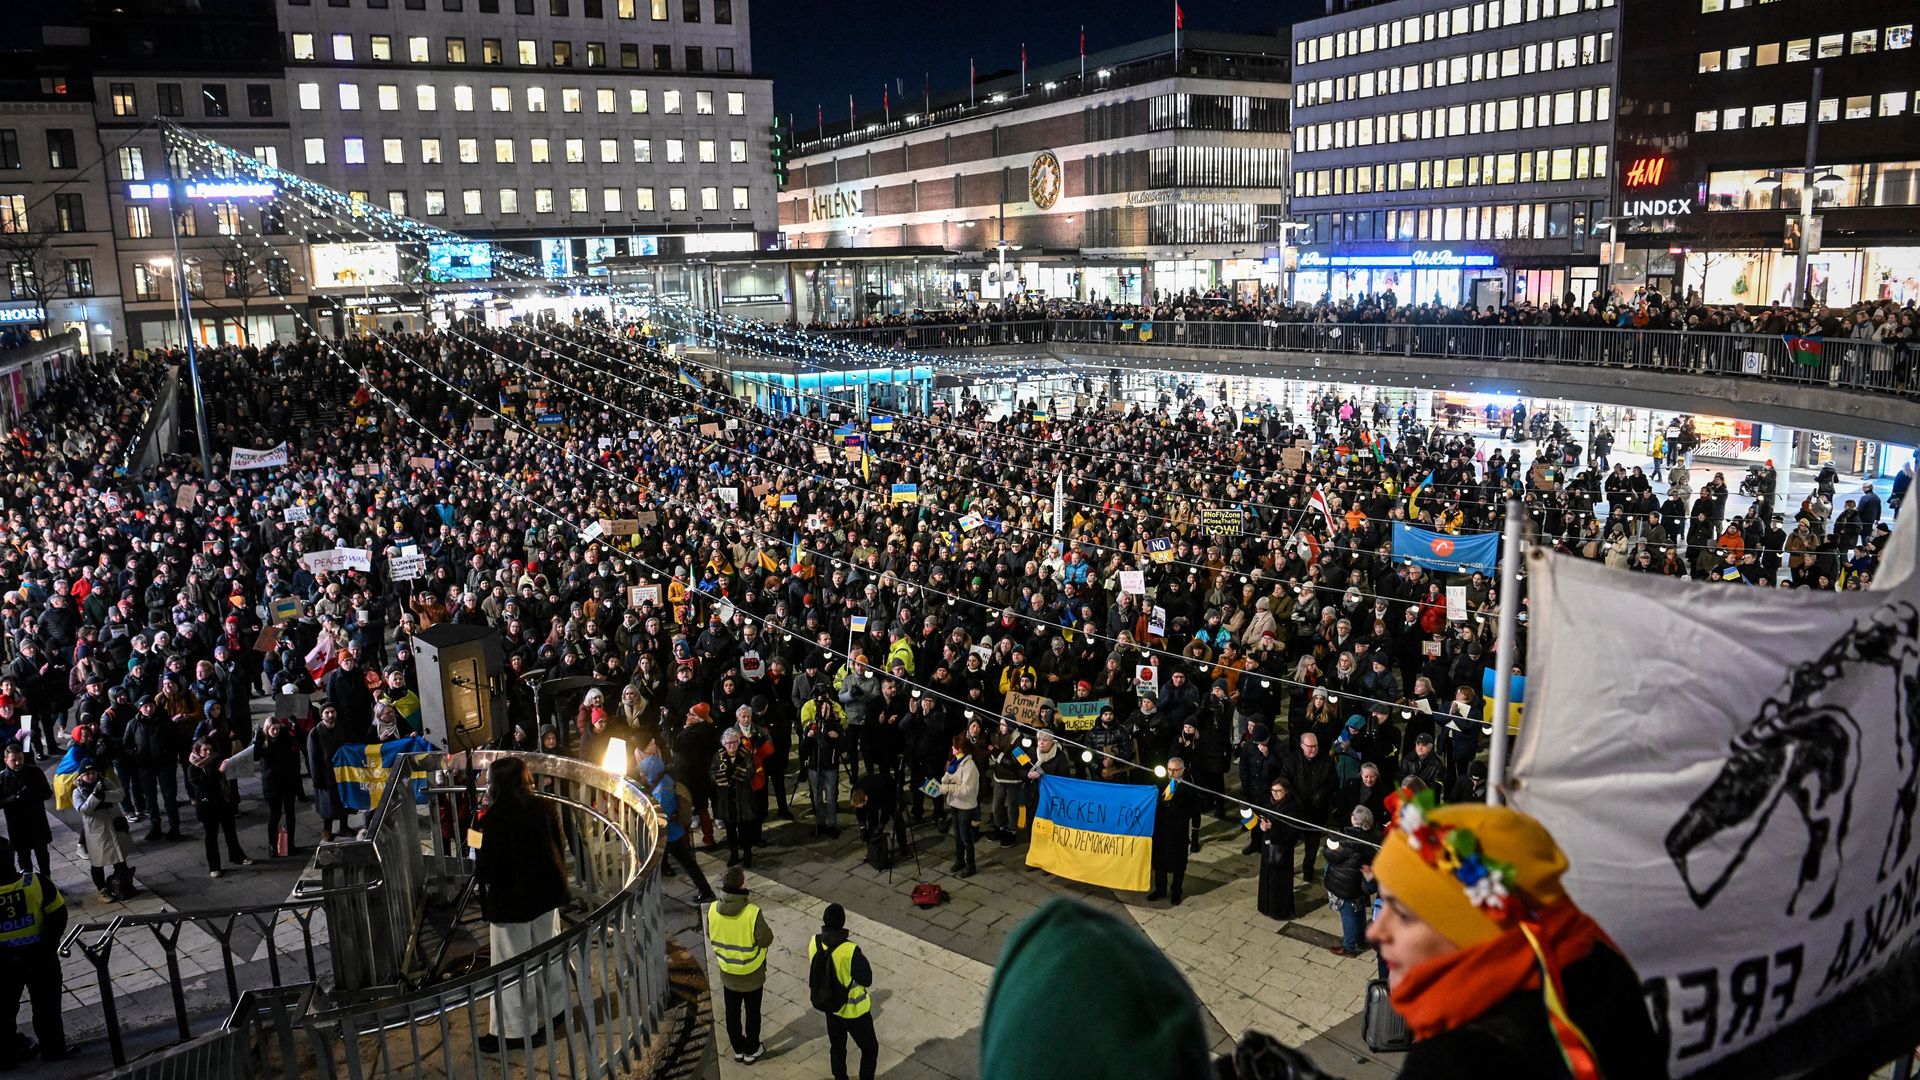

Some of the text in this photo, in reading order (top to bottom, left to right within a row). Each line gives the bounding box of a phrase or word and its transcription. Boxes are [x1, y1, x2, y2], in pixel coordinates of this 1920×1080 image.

[1627, 158, 1664, 187] H&M
[811, 187, 858, 222] ÅHLÉNS
[1624, 199, 1692, 216] LINDEX
[1204, 511, 1240, 519] #NoFlyZone
[1152, 539, 1166, 551] NO
[314, 555, 344, 568] PEACE
[1005, 704, 1019, 716] GO
[1069, 703, 1098, 714] PUTIN
[1051, 796, 1106, 824] FACKEN
[7, 906, 16, 918] 3
[0, 915, 34, 932] OLIS
